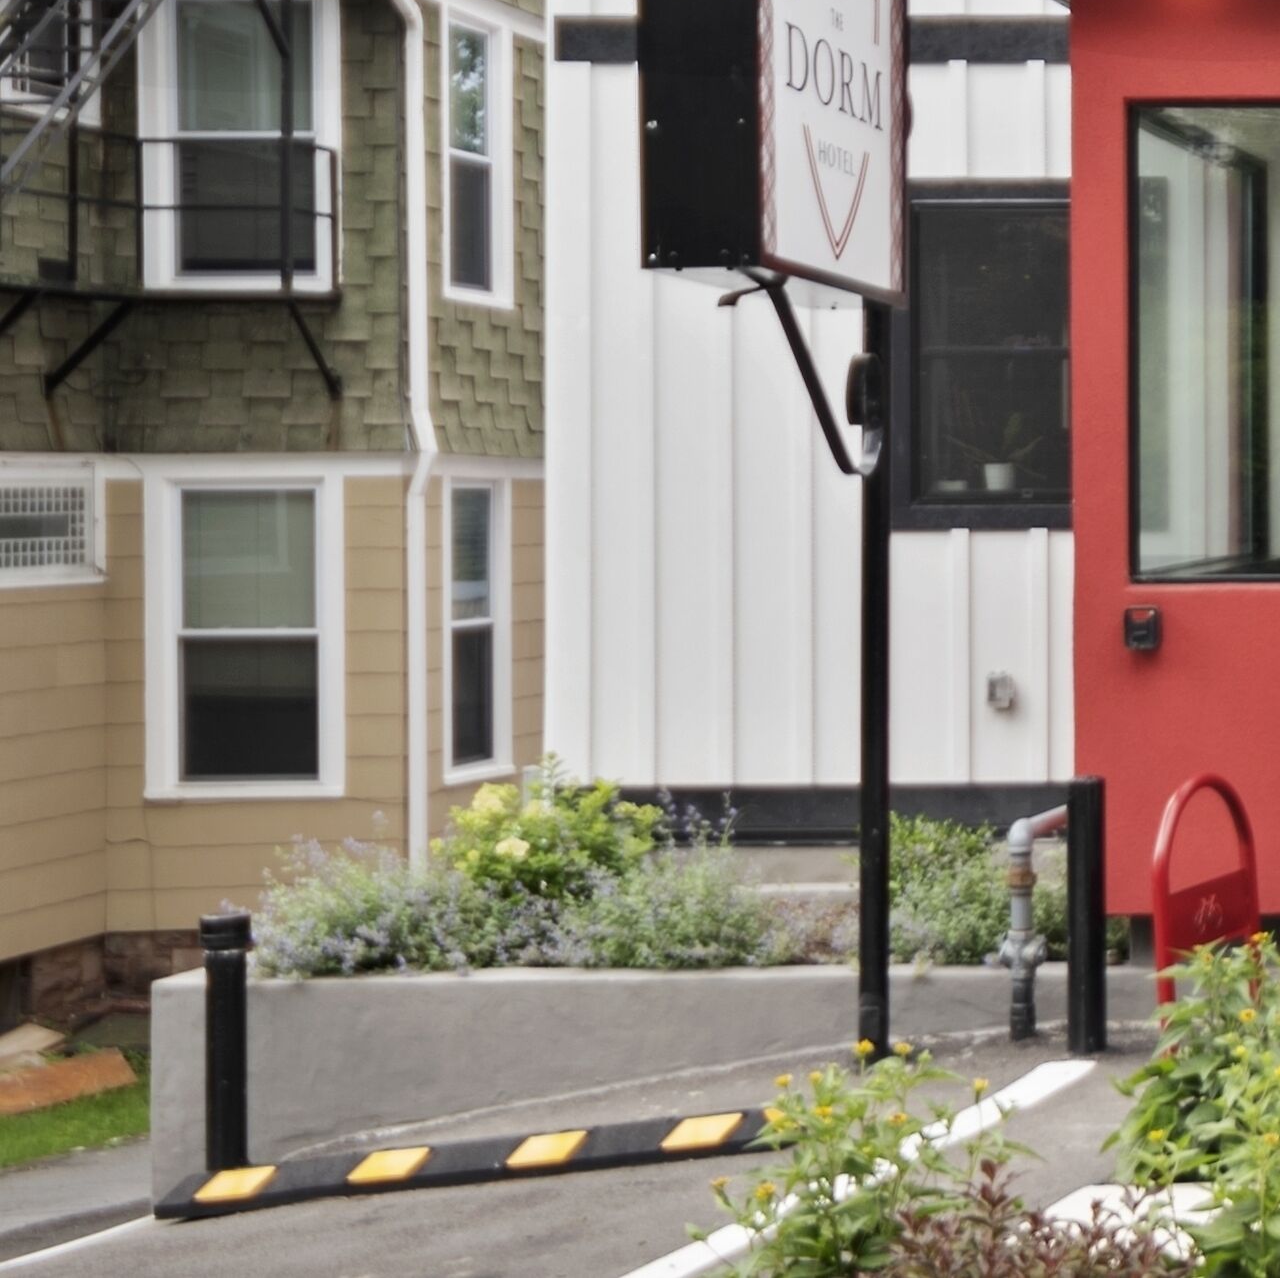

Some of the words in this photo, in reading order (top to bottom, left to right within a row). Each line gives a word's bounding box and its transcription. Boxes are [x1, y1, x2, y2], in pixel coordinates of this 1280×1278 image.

[831, 6, 844, 32] THE
[786, 21, 883, 131] DORM
[818, 138, 856, 177] HOTEL
